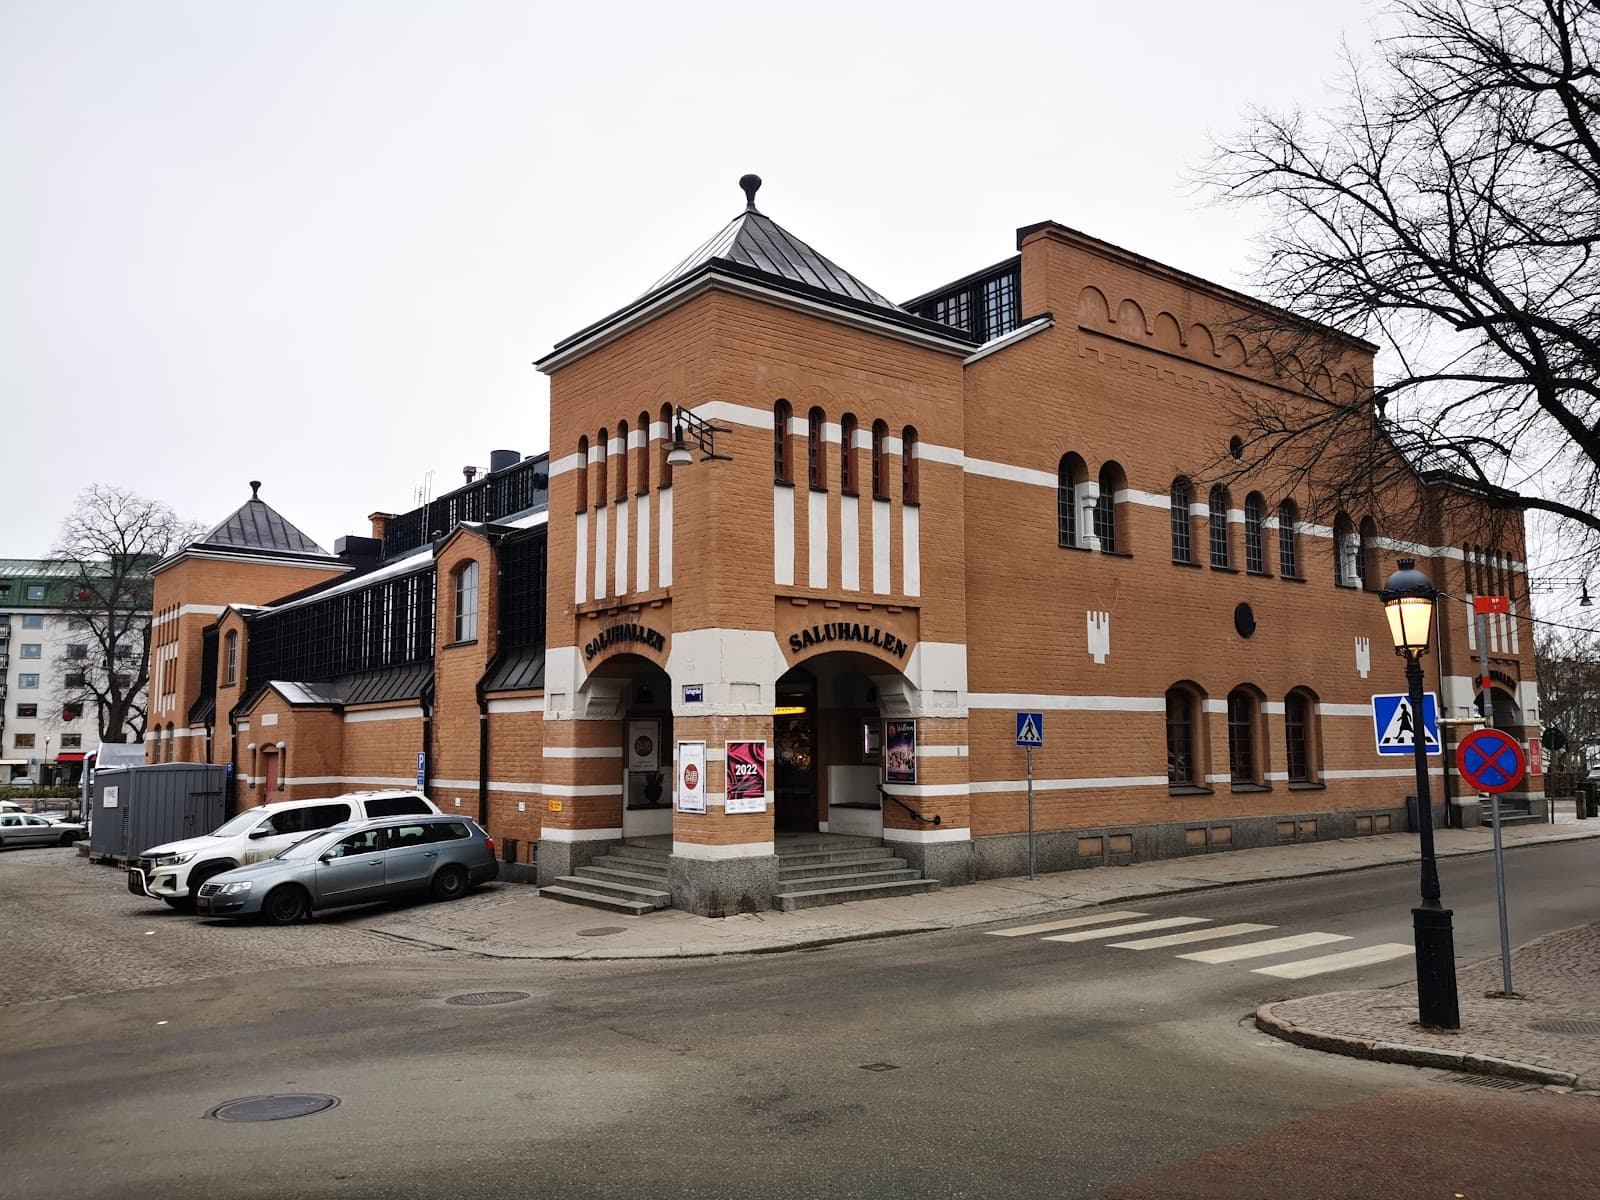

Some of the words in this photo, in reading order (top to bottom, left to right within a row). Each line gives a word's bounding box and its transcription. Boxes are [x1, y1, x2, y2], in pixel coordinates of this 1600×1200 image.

[585, 623, 666, 661] SALUHALLEN
[789, 622, 908, 659] SALUHALLEN
[735, 764, 757, 775] 2022
